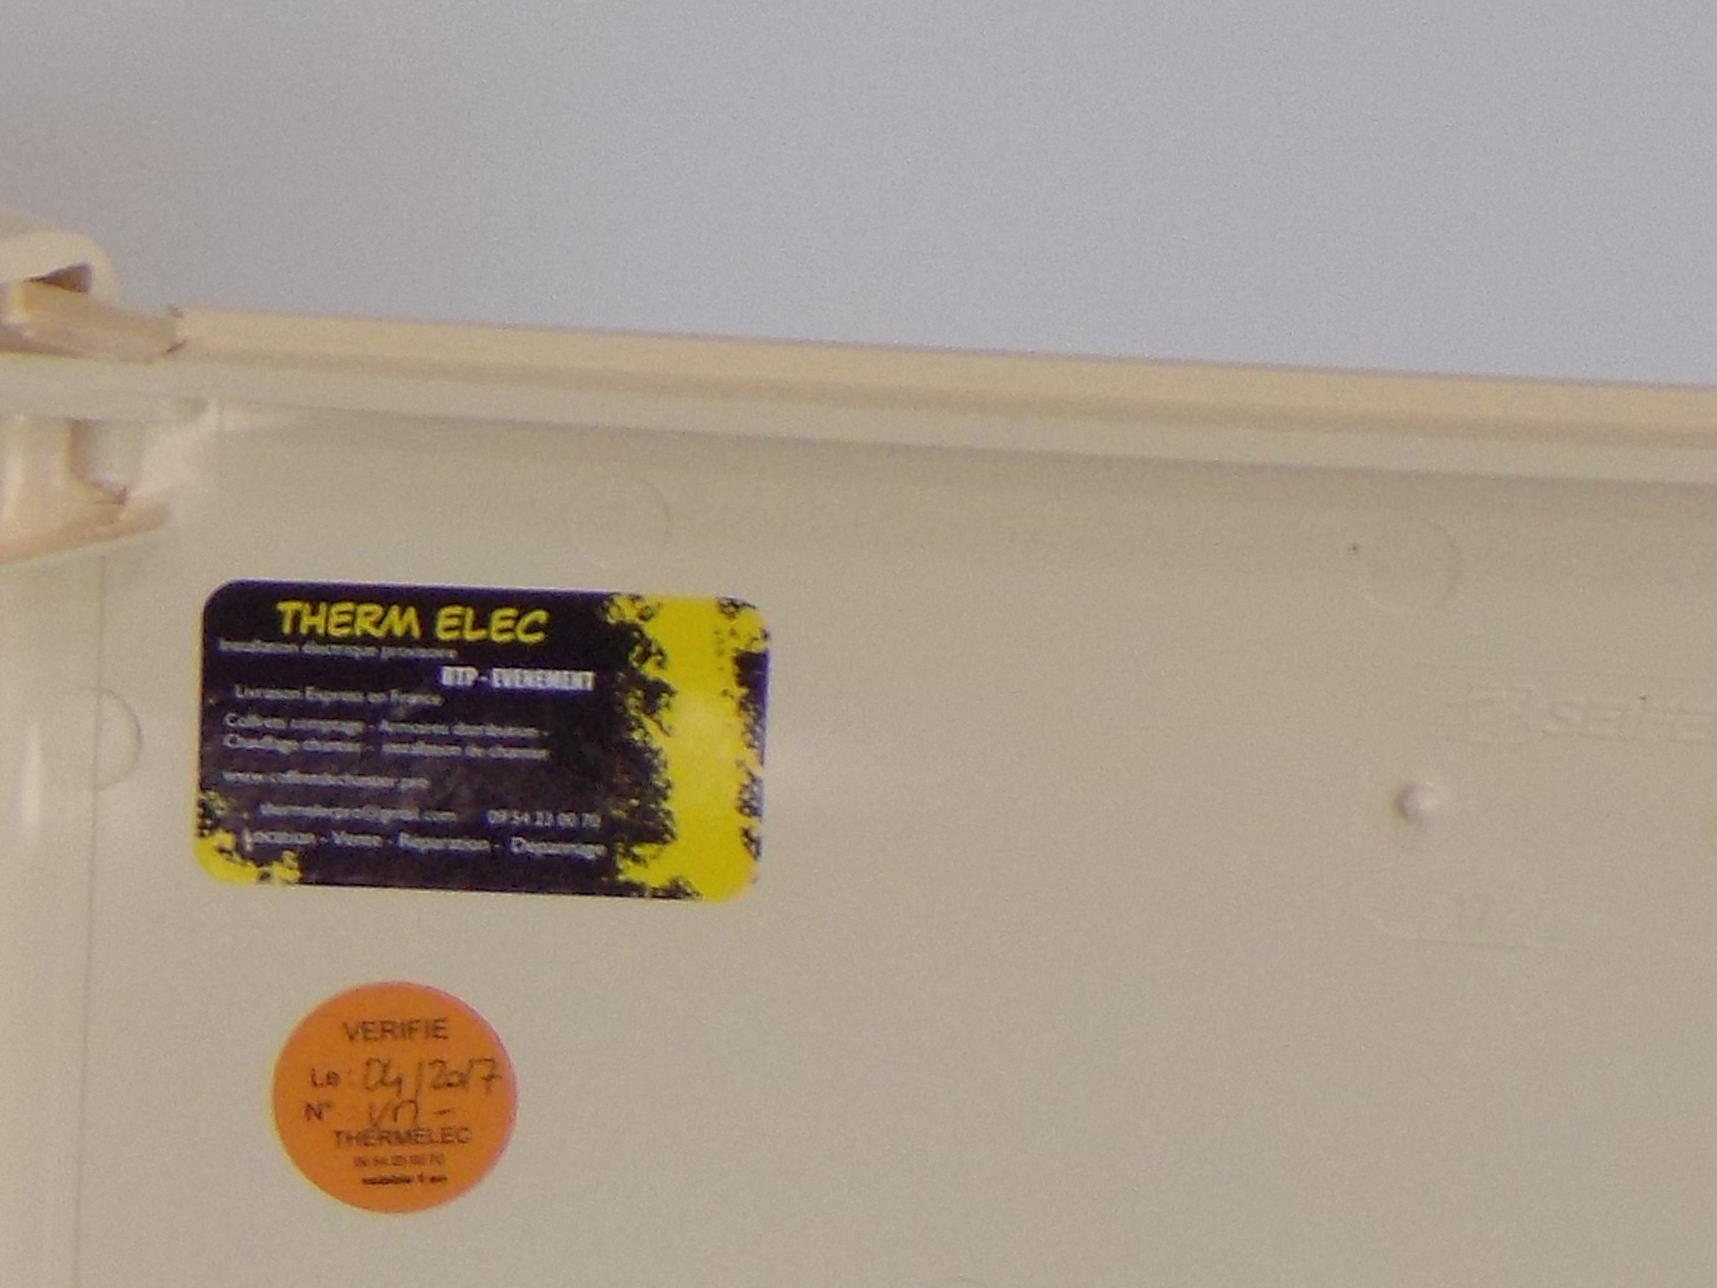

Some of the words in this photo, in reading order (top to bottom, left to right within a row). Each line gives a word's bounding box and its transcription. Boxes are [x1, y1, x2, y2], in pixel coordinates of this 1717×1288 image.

[276, 601, 420, 638] THERM
[436, 604, 550, 643] ELEC
[341, 1018, 447, 1041] VERIFIE
[333, 1127, 472, 1147] THERMELEC
